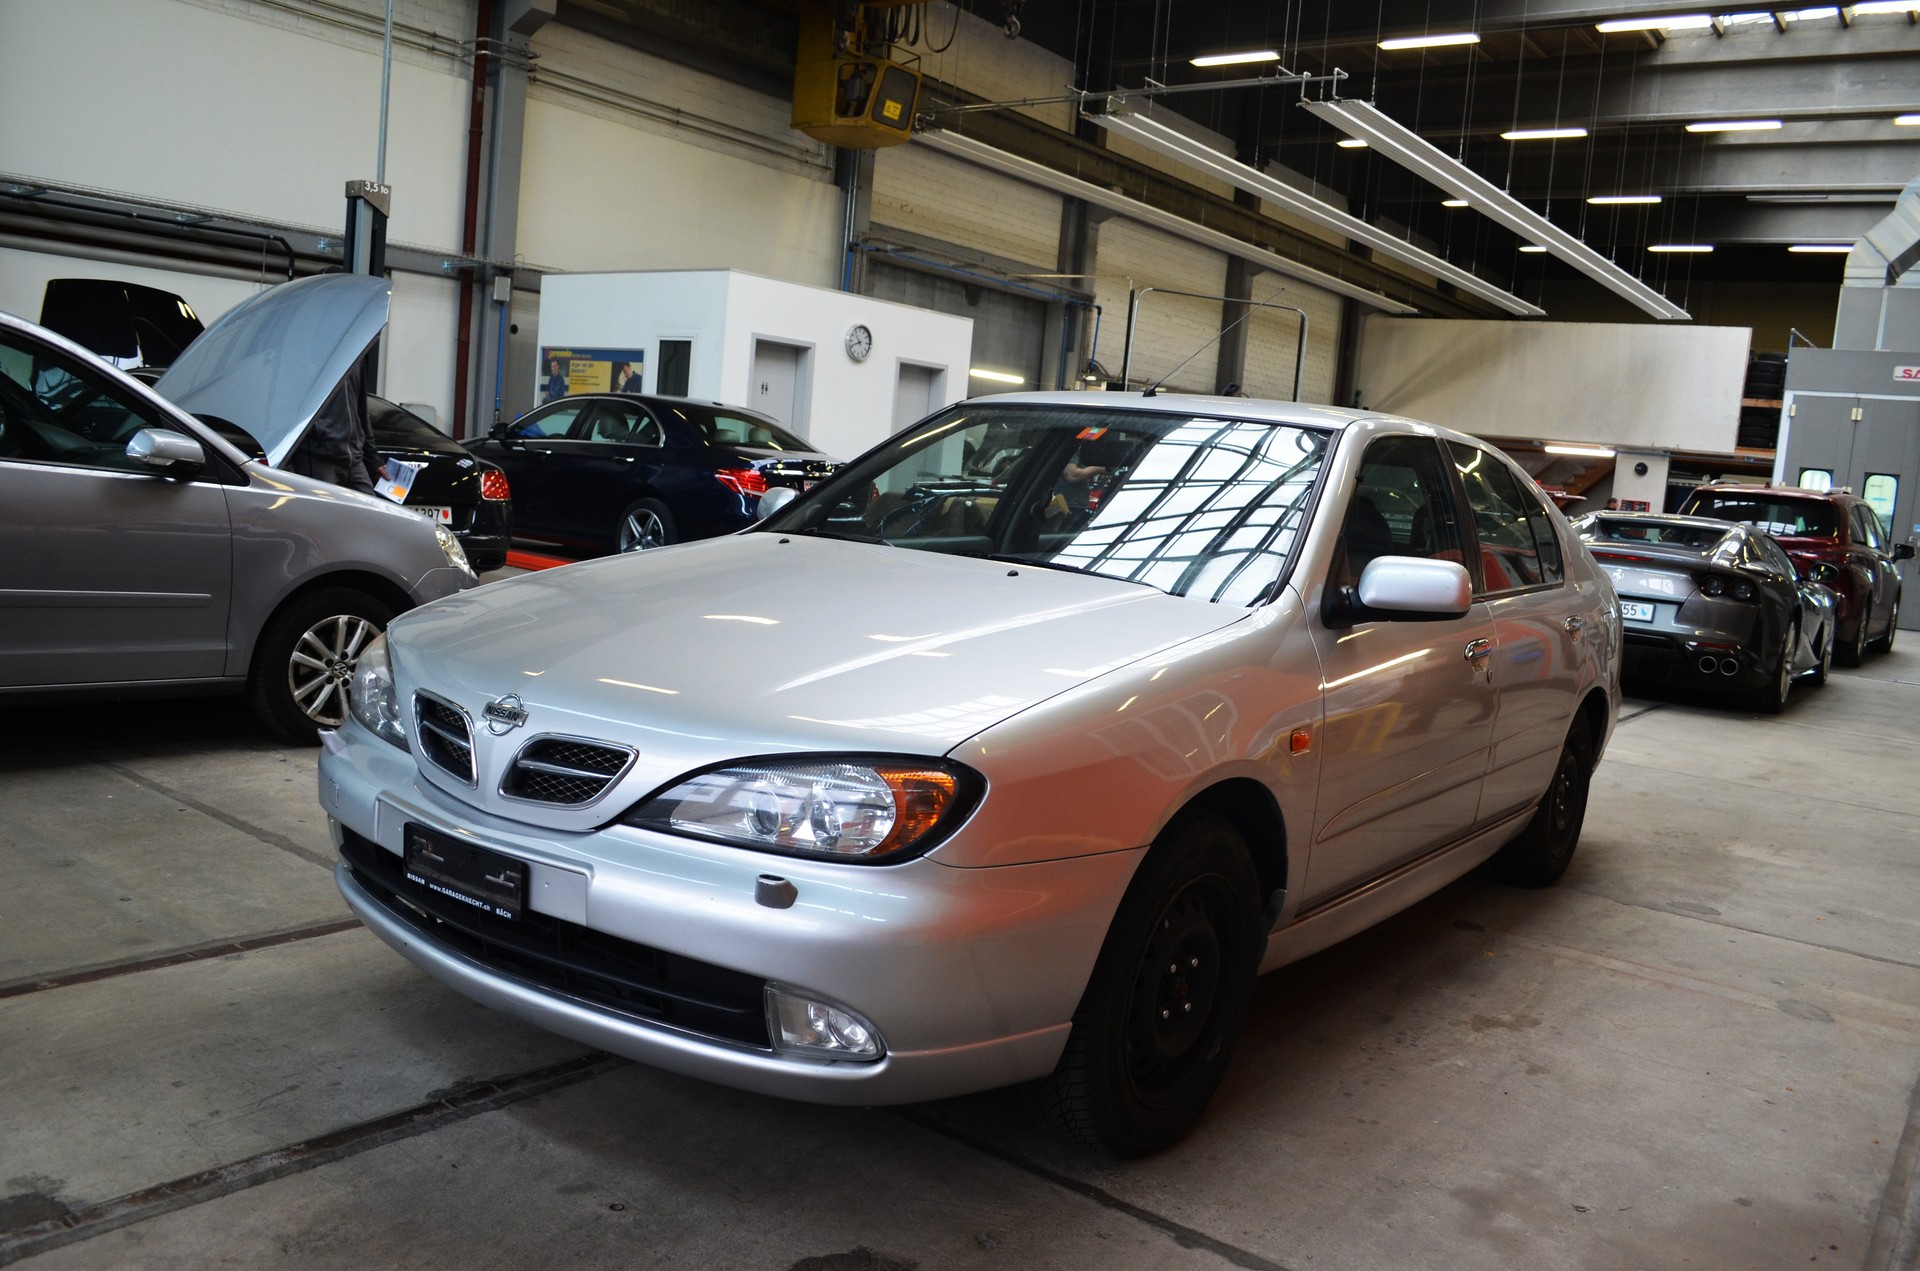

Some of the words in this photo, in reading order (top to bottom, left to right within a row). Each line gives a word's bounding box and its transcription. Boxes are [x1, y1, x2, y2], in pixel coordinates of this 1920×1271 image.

[364, 181, 379, 193] 3,5
[486, 705, 520, 722] NISSAN
[407, 872, 426, 885] NISSAN
